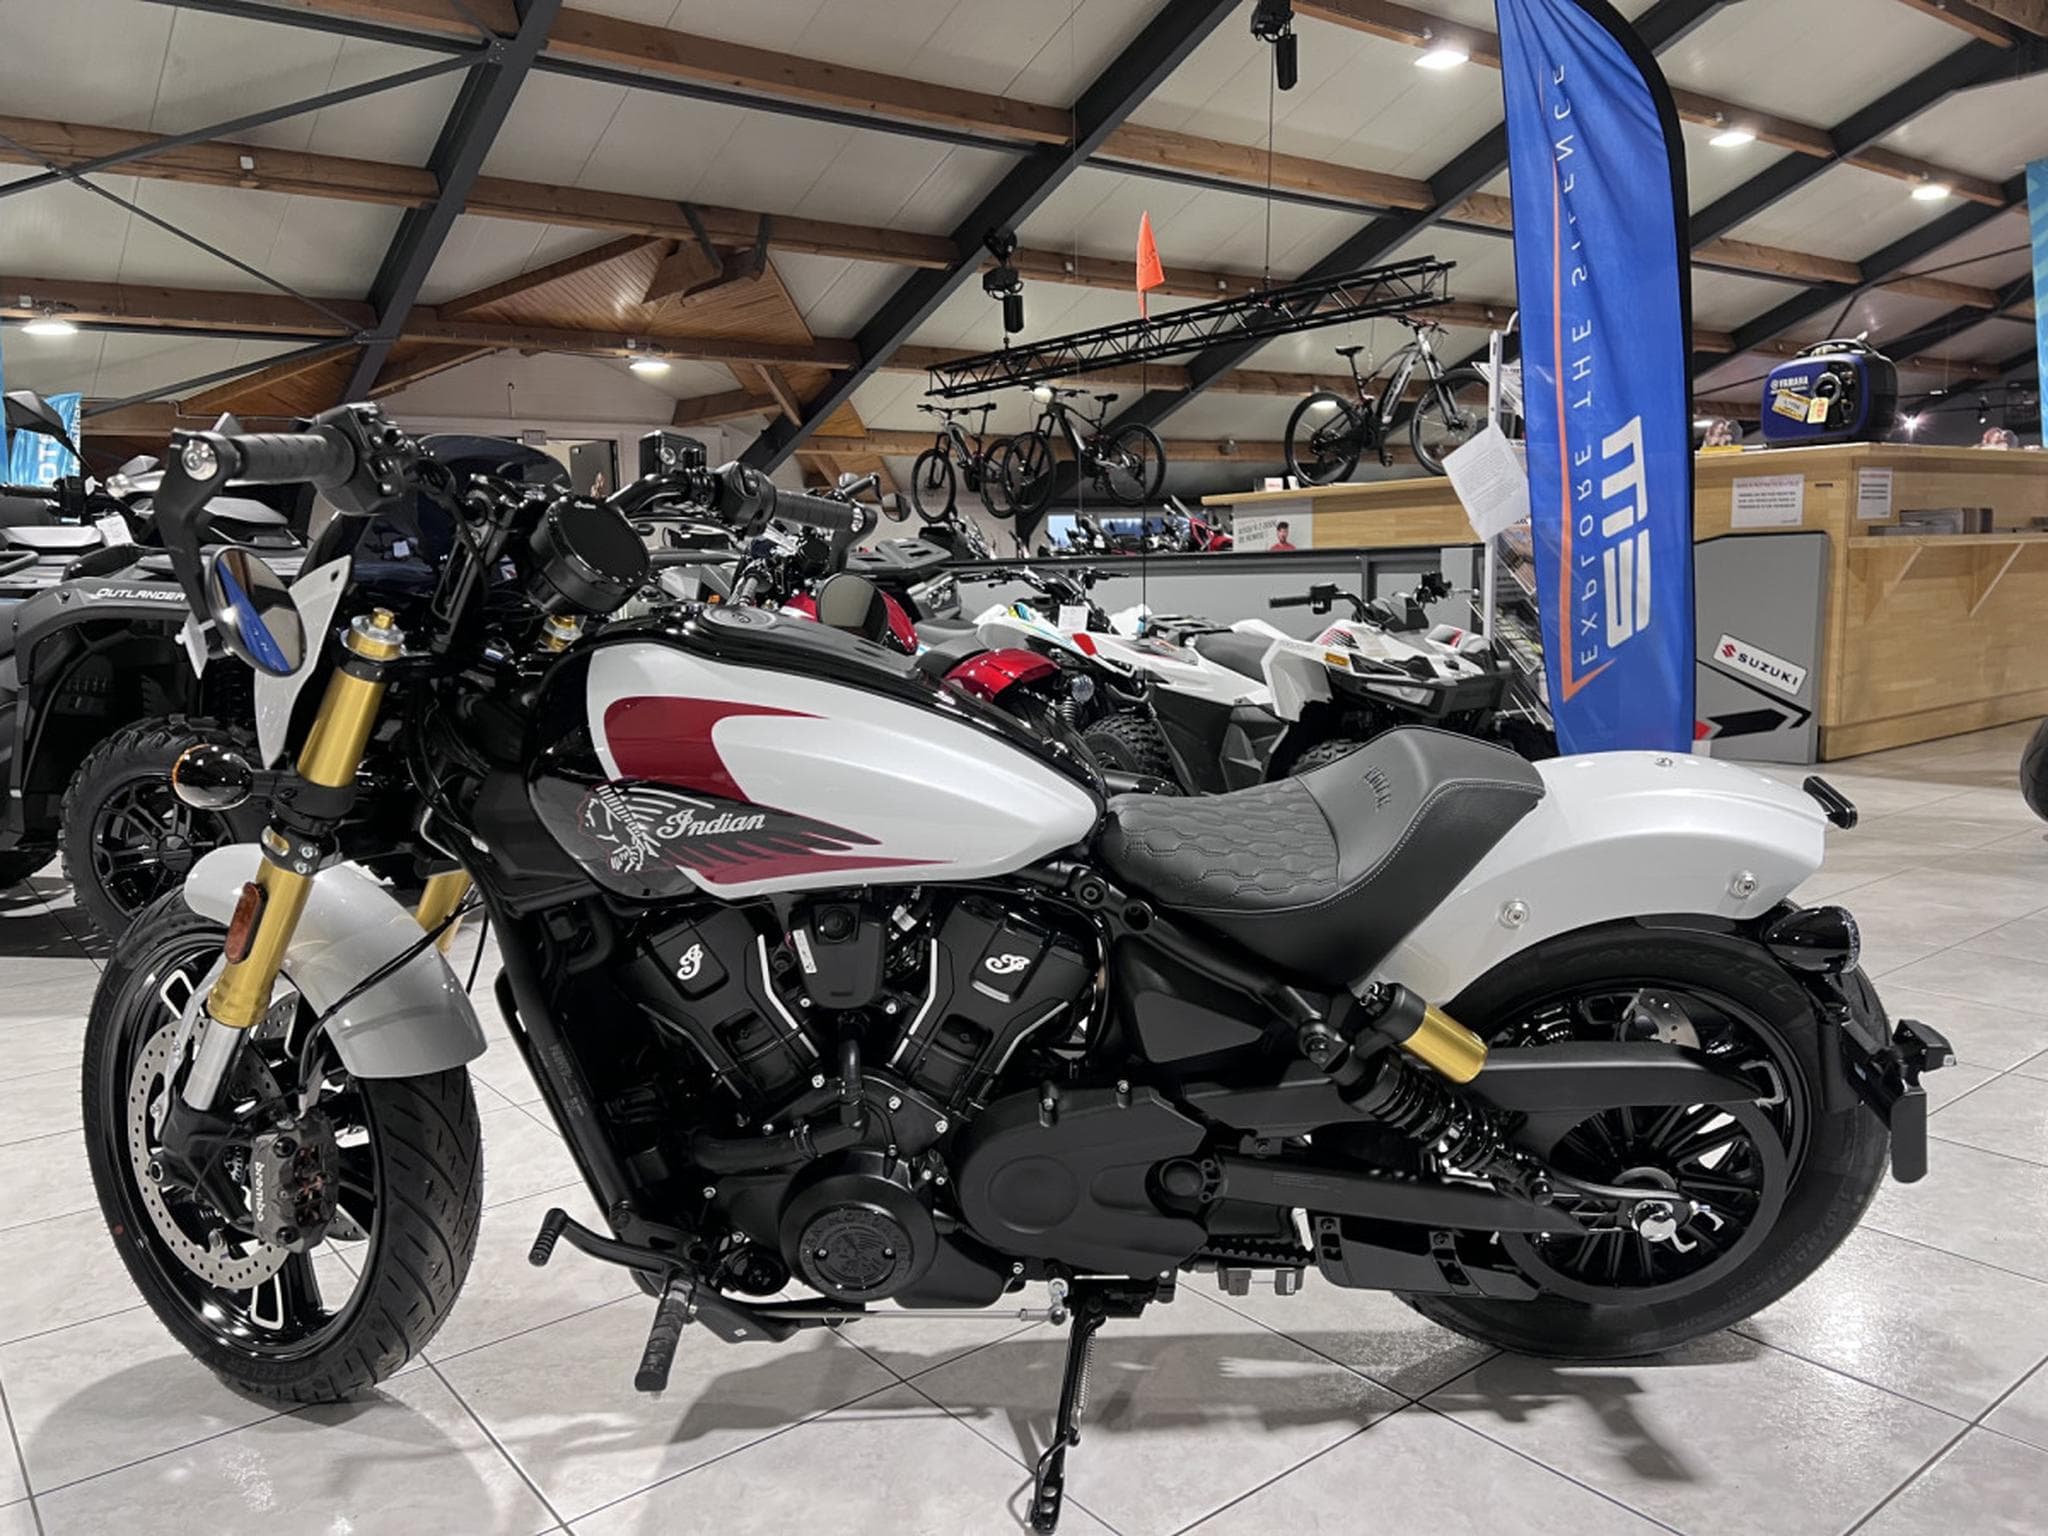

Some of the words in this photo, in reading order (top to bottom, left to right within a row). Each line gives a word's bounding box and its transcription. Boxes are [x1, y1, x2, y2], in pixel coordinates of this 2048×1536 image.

[1779, 376, 1808, 388] YAMAHA
[96, 588, 187, 601] OUTLANDER
[1738, 652, 1799, 686] SUZUKI
[656, 808, 766, 839] Indian
[254, 1161, 266, 1222] brembo
